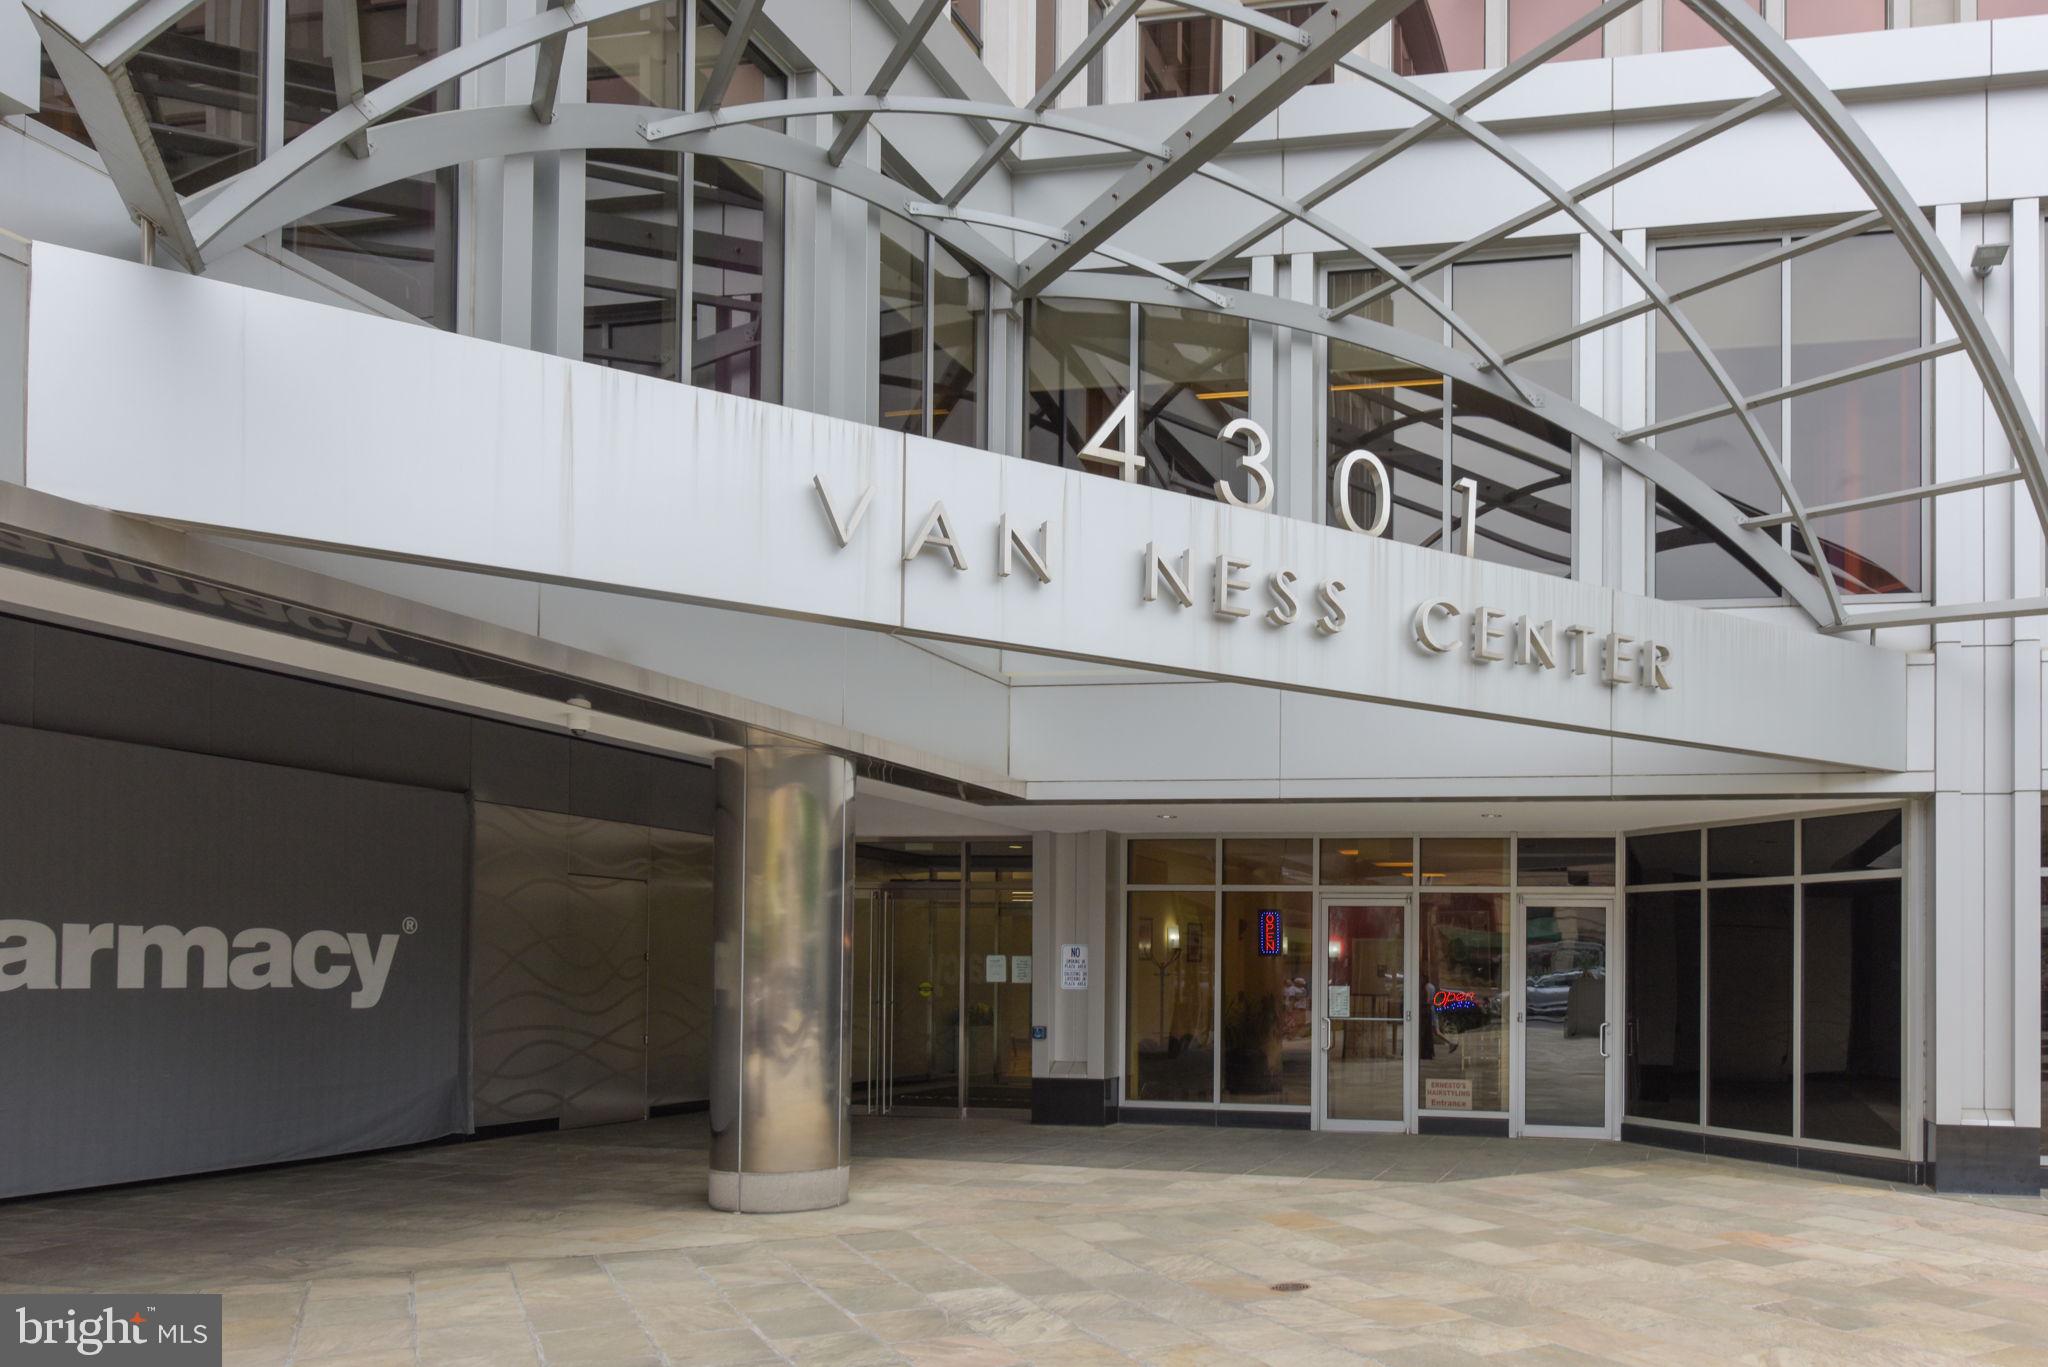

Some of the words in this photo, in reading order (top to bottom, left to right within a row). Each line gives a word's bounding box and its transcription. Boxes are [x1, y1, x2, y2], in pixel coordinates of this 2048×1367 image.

[1077, 390, 1478, 558] 4301
[813, 474, 1052, 585] VAN
[1143, 541, 1348, 635] NESS
[1413, 599, 1673, 691] CENTER
[1265, 914, 1275, 951] OPEN
[1071, 947, 1081, 958] NO
[1433, 991, 1475, 1006] Open
[1427, 1089, 1471, 1097] HAIRSTYLING
[1431, 1099, 1467, 1107] Entrance
